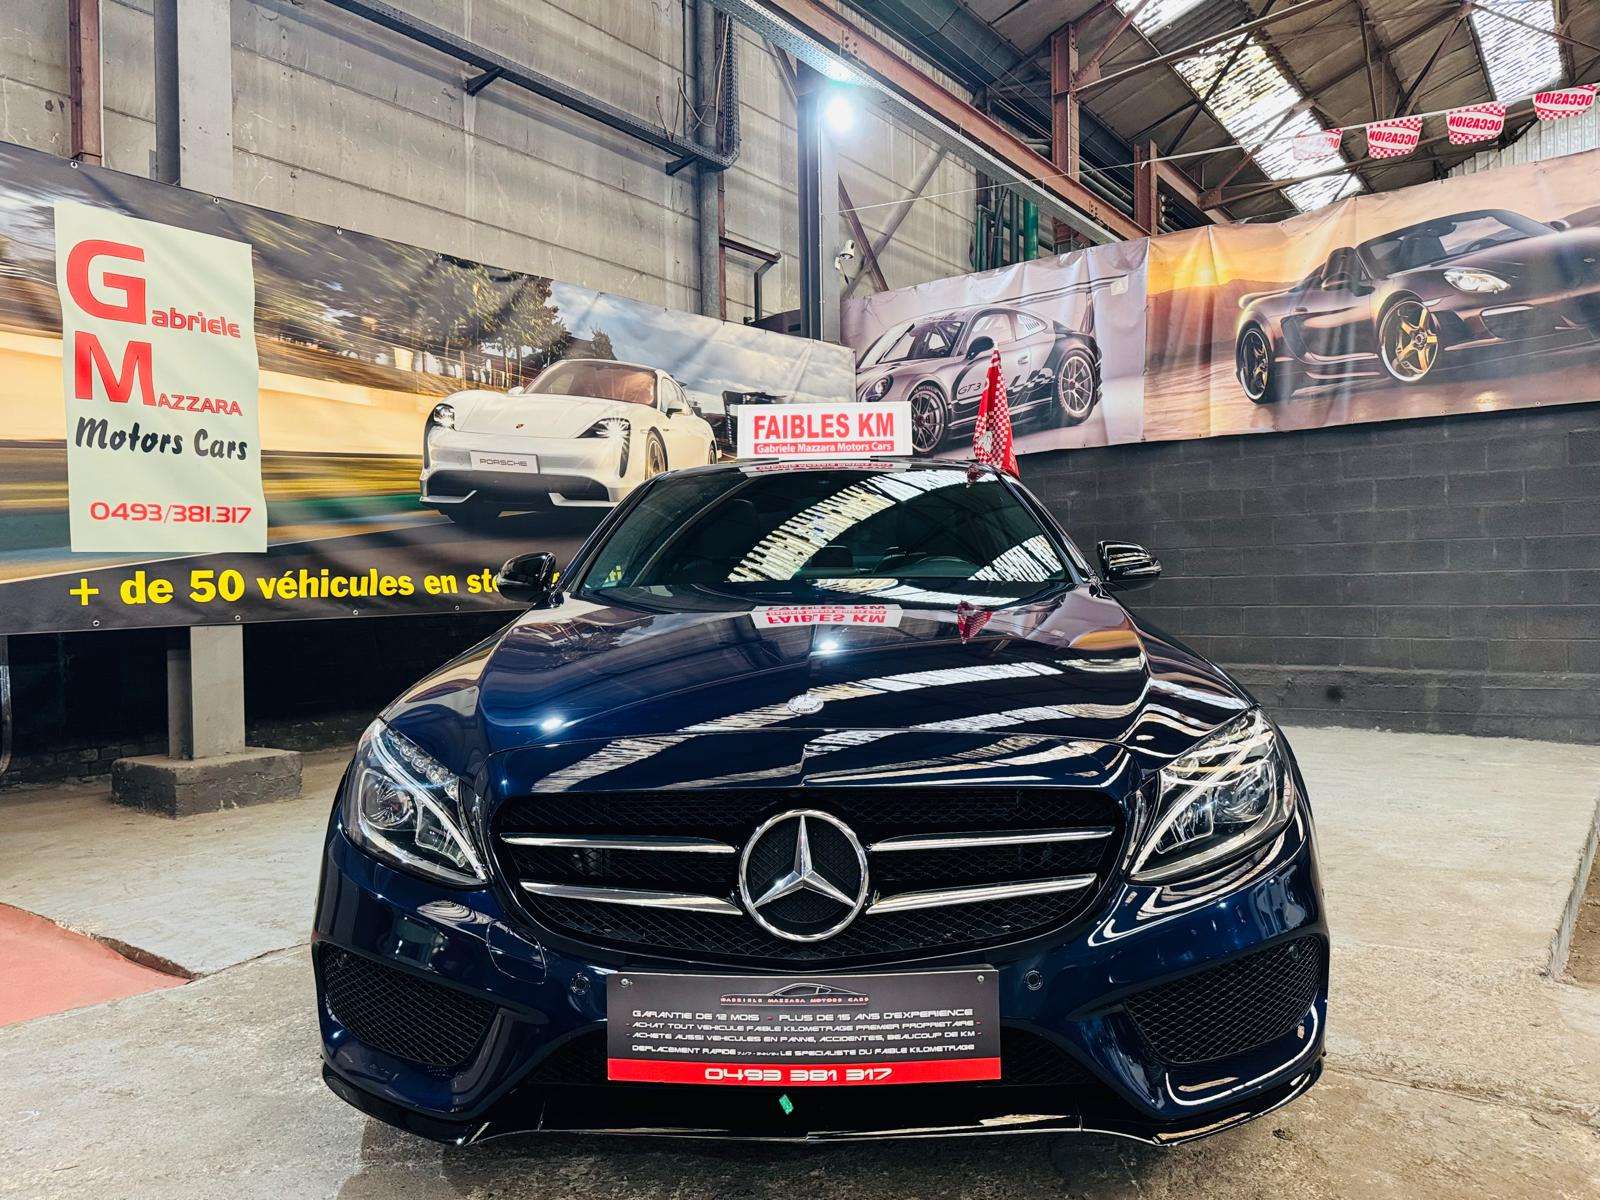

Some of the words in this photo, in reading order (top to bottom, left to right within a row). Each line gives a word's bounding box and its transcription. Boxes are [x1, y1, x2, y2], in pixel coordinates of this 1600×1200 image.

[958, 382, 982, 394] GT3
[753, 413, 850, 439] FAIBLES
[858, 412, 894, 438] KM
[75, 416, 183, 454] Motors
[193, 428, 248, 460] Cars
[757, 443, 796, 454] Gabriele
[797, 442, 835, 453] Mazzara
[837, 441, 870, 452] Motors
[871, 441, 891, 451] Cars
[479, 458, 528, 467] PORSCHE
[90, 502, 252, 524] 0493/381.317
[119, 570, 174, 605] de
[188, 569, 246, 603] 50
[256, 568, 415, 601] véhicules
[423, 573, 459, 595] en
[632, 1010, 693, 1020] GARANTIE
[695, 1012, 714, 1020] DE
[730, 1013, 760, 1021] MOIS
[779, 1013, 813, 1021] PLUS
[816, 1013, 834, 1021] DE
[837, 1013, 851, 1021] 15
[854, 1012, 880, 1020] ANS
[883, 1008, 973, 1019] D'EXPERIENCE
[697, 1024, 744, 1032] VEHICULE
[856, 1022, 900, 1031] PREMIER
[901, 1020, 974, 1029] PROPRIETAIRE
[632, 1032, 672, 1040] ACHETE
[674, 1033, 704, 1041] AUSSI
[887, 1031, 942, 1040] BEAUCOUP
[944, 1030, 958, 1038] DE
[632, 1044, 700, 1054] DEPLACEMENT
[874, 1047, 908, 1055] FAIBLE
[910, 1044, 975, 1053] KILOMETRAGE
[704, 1067, 782, 1081] 0493
[790, 1067, 837, 1081] 381
[845, 1067, 893, 1081] 317
